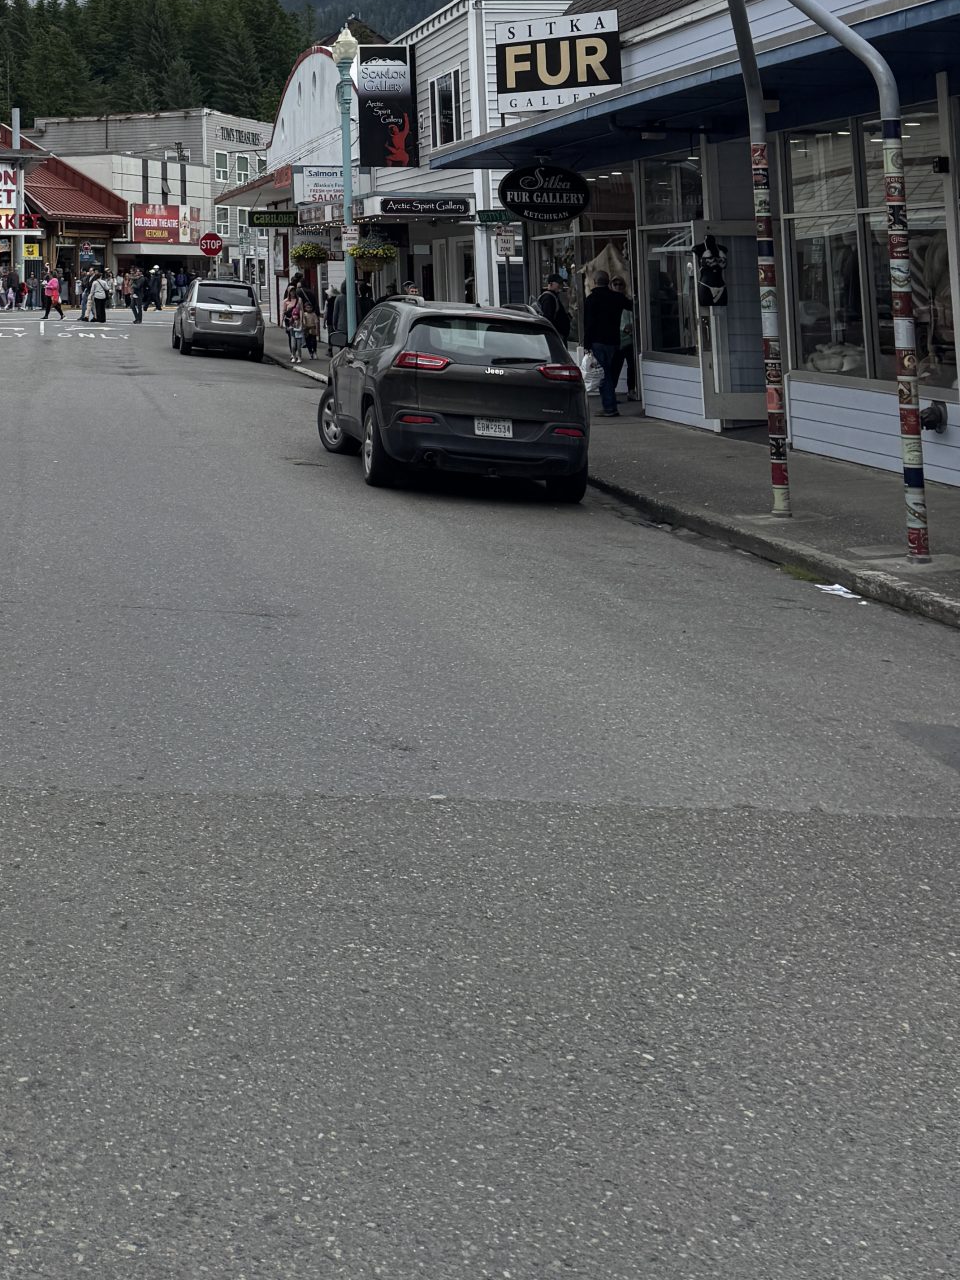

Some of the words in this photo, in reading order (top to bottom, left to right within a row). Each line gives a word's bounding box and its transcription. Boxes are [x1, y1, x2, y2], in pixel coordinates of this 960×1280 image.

[507, 16, 606, 40] SITKA
[505, 37, 611, 89] FUR
[365, 99, 384, 108] Arctic
[372, 108, 391, 117] Spirit
[380, 115, 403, 125] Gallery
[519, 167, 572, 190] Sitka
[506, 191, 530, 203] FUR
[533, 192, 585, 205] GALLERY
[386, 201, 410, 210] Arctic
[411, 201, 435, 212] Spirit
[435, 201, 465, 213] Gallery
[523, 209, 569, 220] KETCHIKAN
[134, 218, 158, 227] COLISEUM
[159, 218, 179, 228] THEATRE
[201, 239, 222, 249] STOP
[485, 367, 504, 376] Jeep
